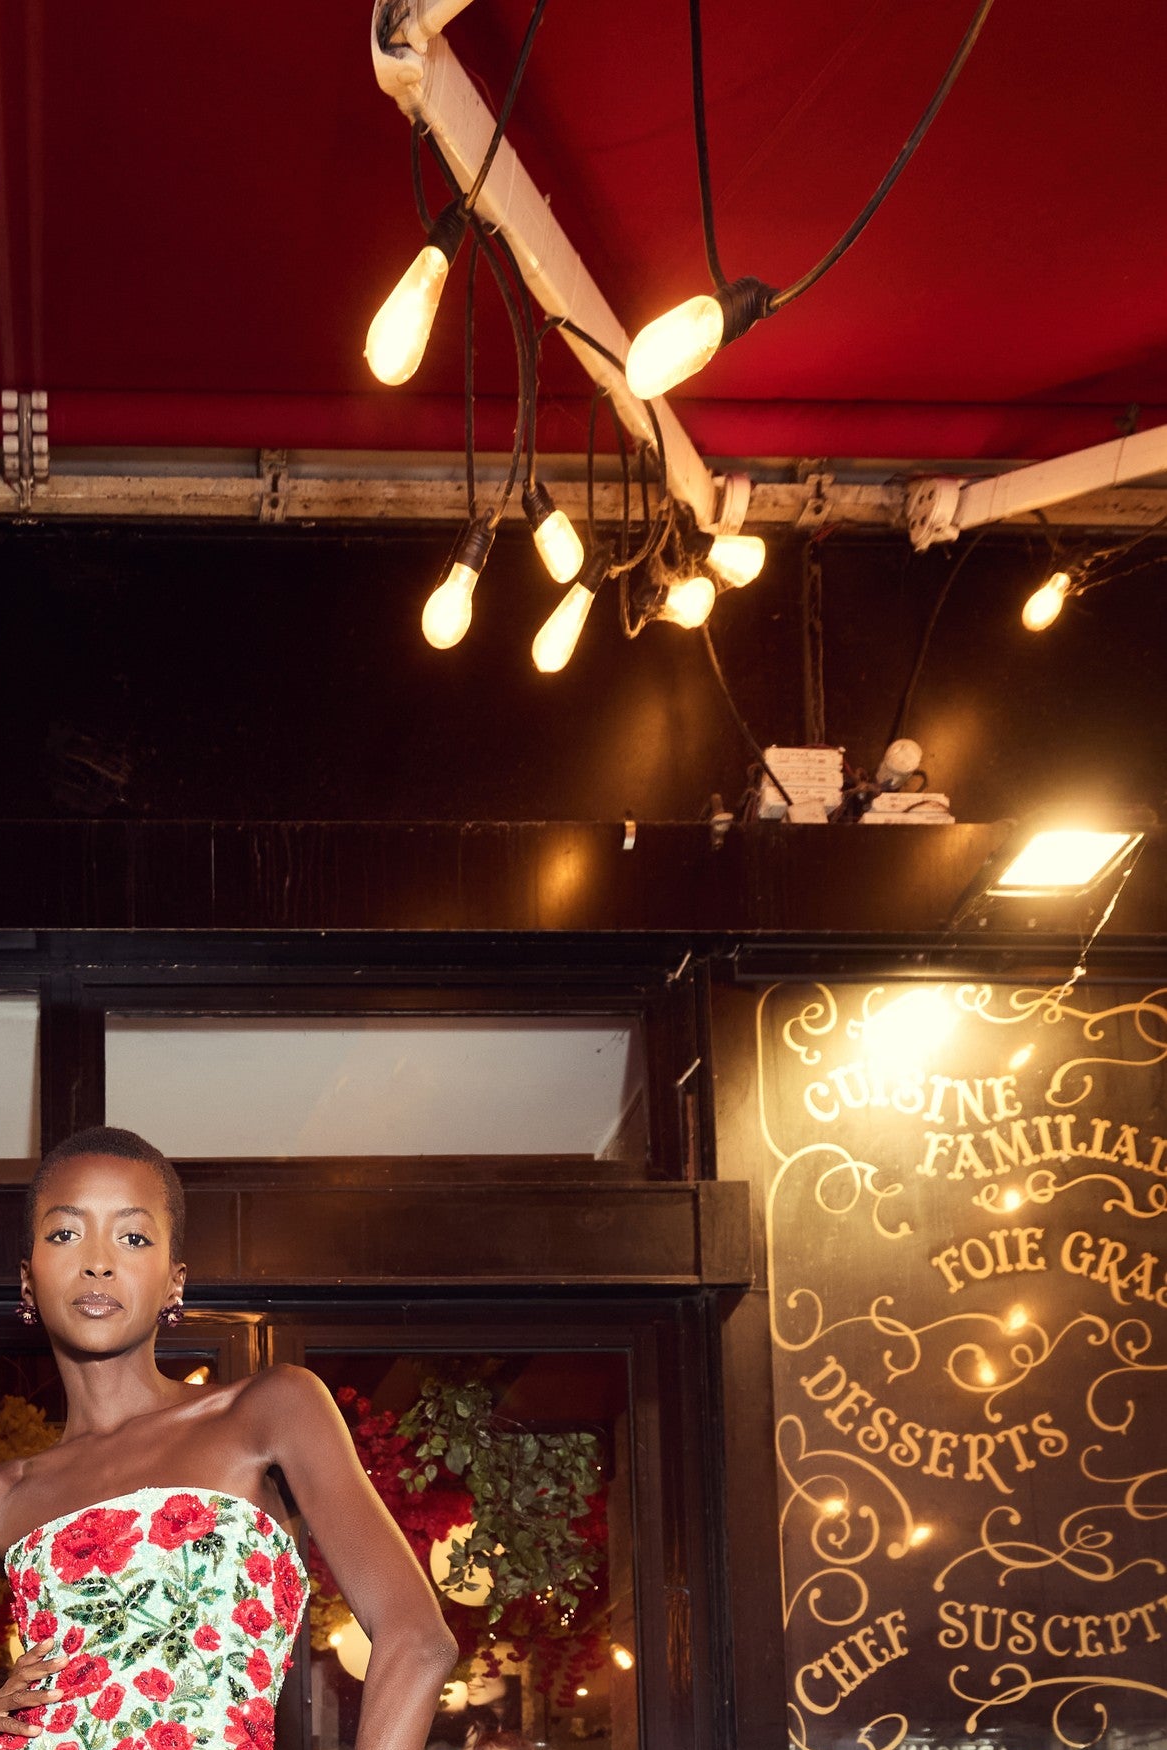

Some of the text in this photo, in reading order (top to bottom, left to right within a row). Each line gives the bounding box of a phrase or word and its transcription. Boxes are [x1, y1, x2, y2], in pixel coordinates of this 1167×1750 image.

[804, 1060, 1022, 1127] CUISINE
[931, 1227, 1048, 1294] FOIE
[800, 1355, 1068, 1494] DESSERTS
[795, 1609, 909, 1715] CHEF
